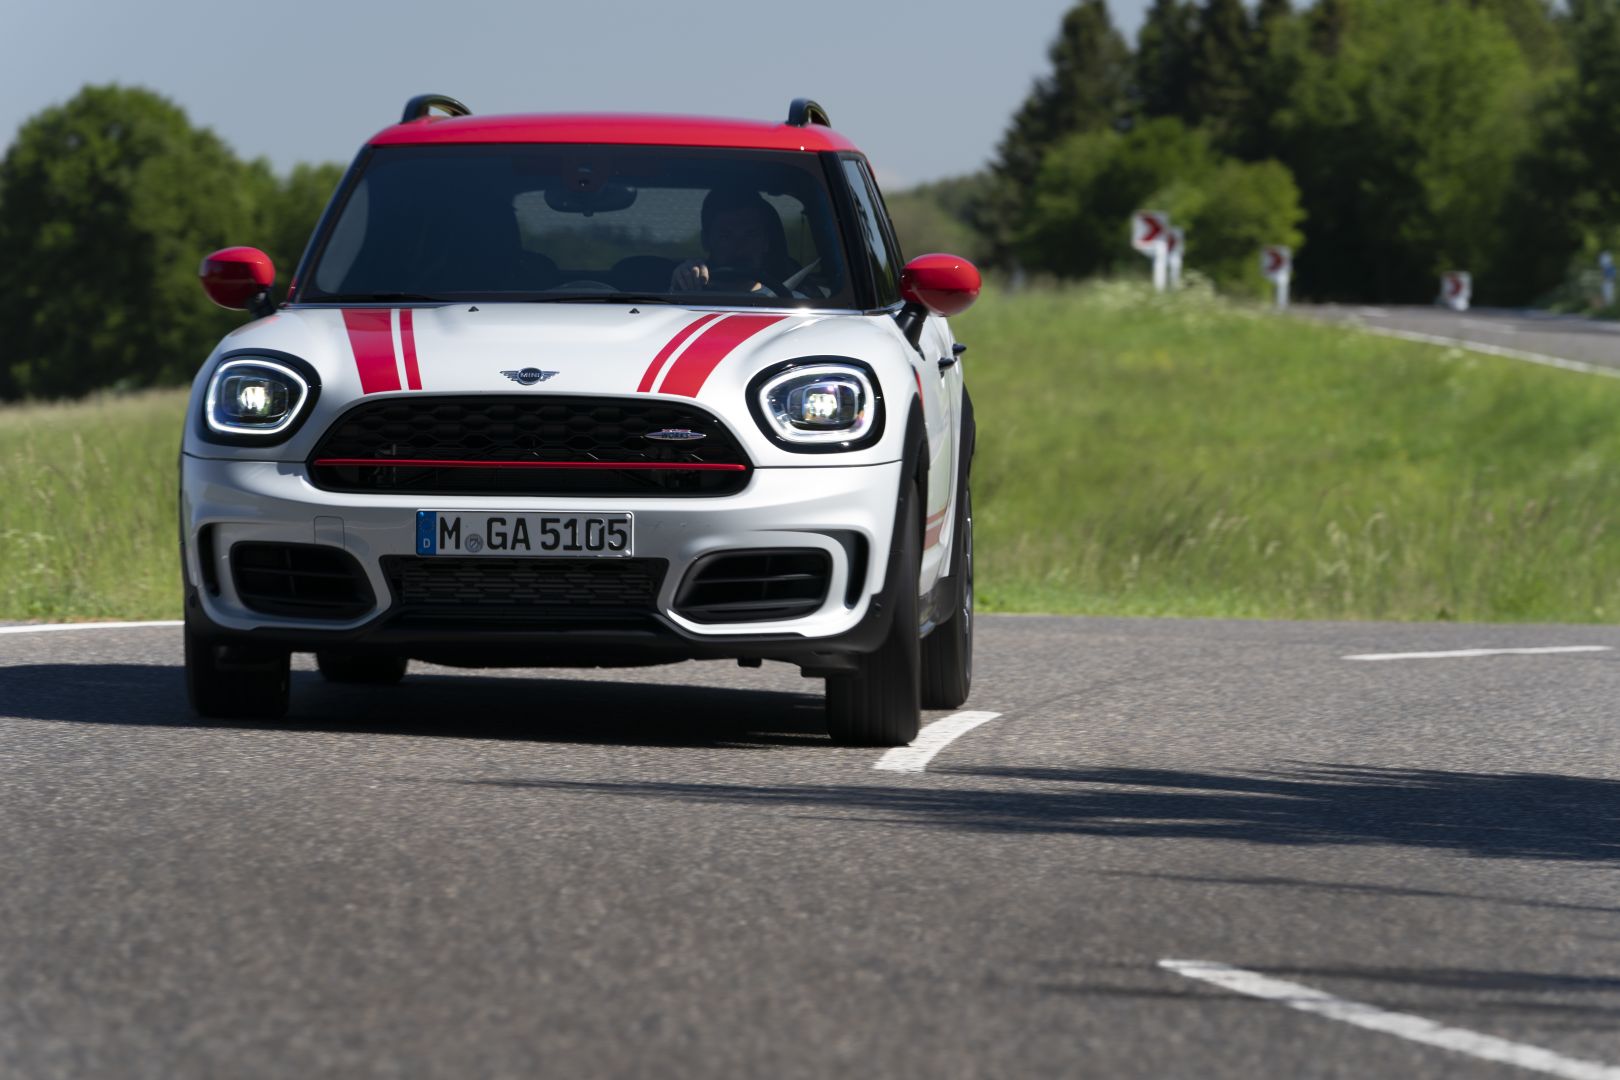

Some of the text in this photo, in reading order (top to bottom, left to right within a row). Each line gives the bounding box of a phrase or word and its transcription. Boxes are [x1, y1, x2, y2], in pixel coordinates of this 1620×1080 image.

[423, 538, 431, 548] D
[439, 516, 628, 551] M GA 5105
